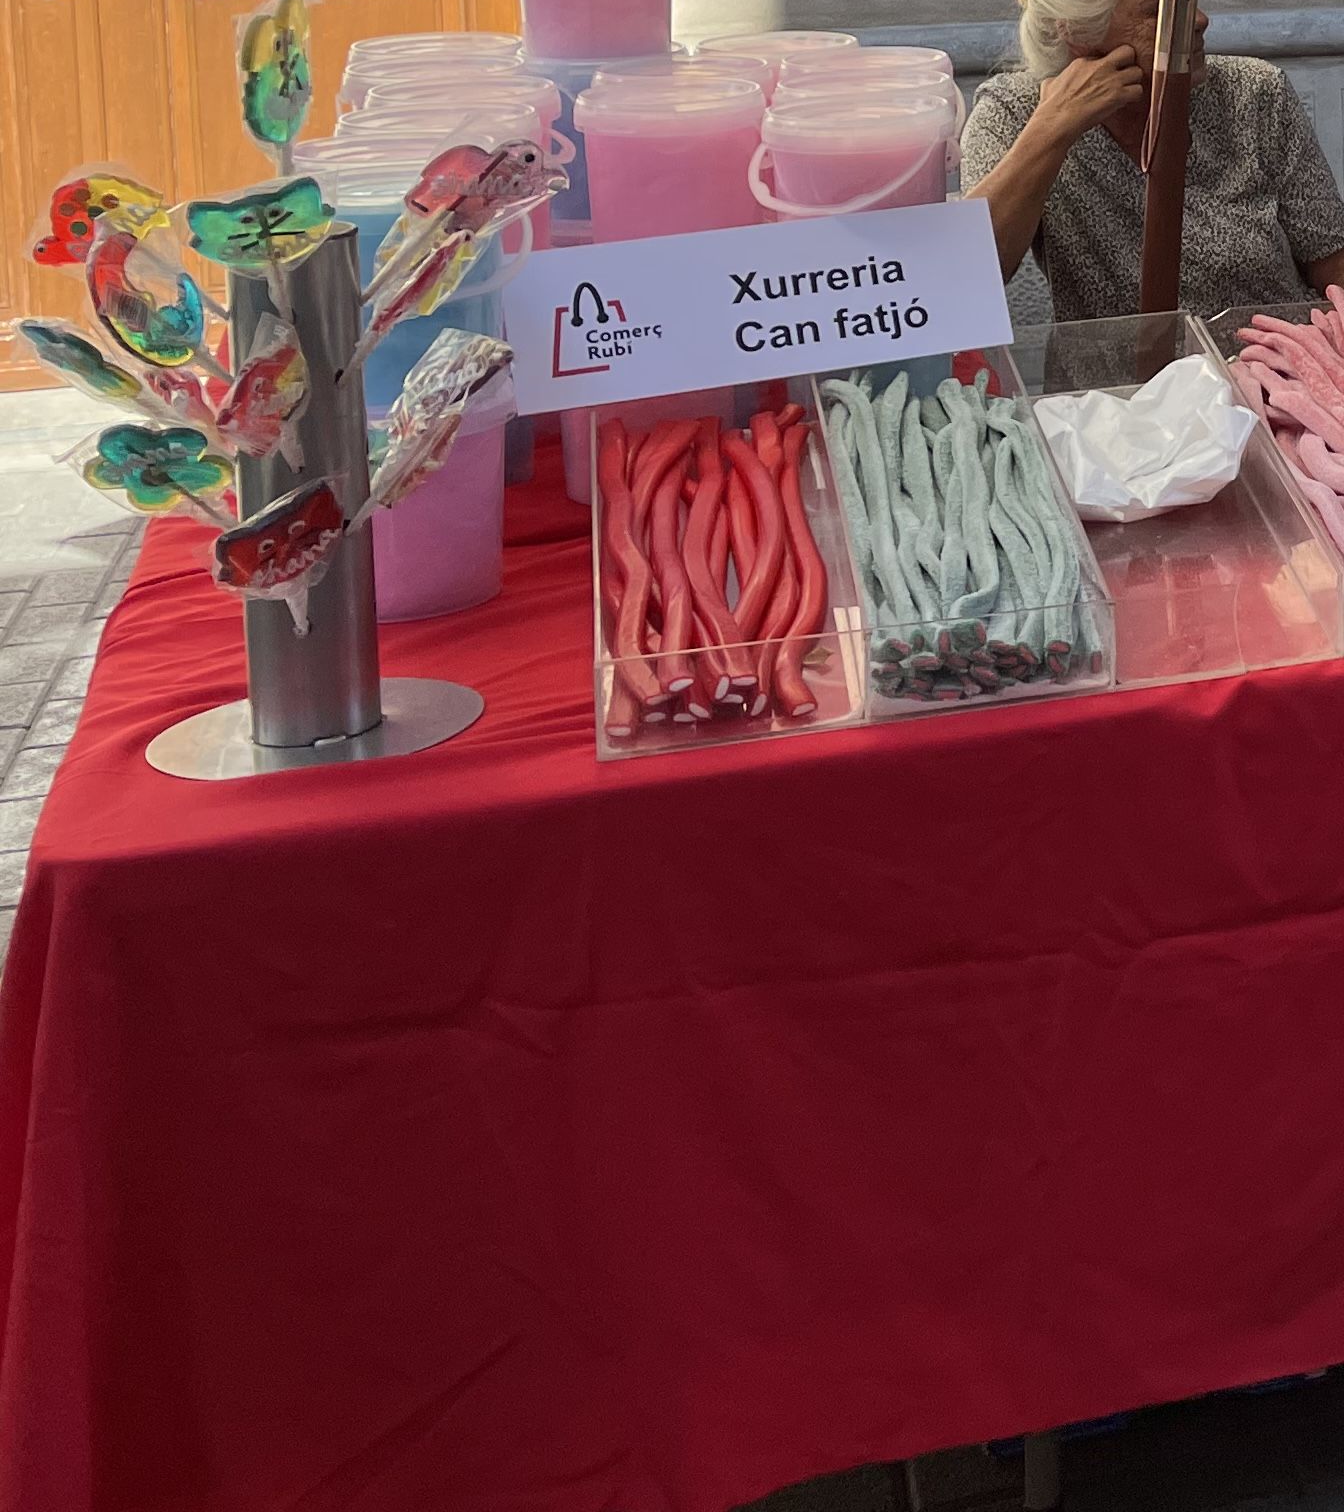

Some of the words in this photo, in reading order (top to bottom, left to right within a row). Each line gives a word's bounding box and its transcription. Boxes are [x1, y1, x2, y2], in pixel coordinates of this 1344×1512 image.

[729, 255, 906, 305] Xurreria
[586, 321, 663, 345] Comerç
[734, 318, 821, 353] Can
[833, 296, 930, 340] fatjó
[588, 341, 633, 360] Rubí
